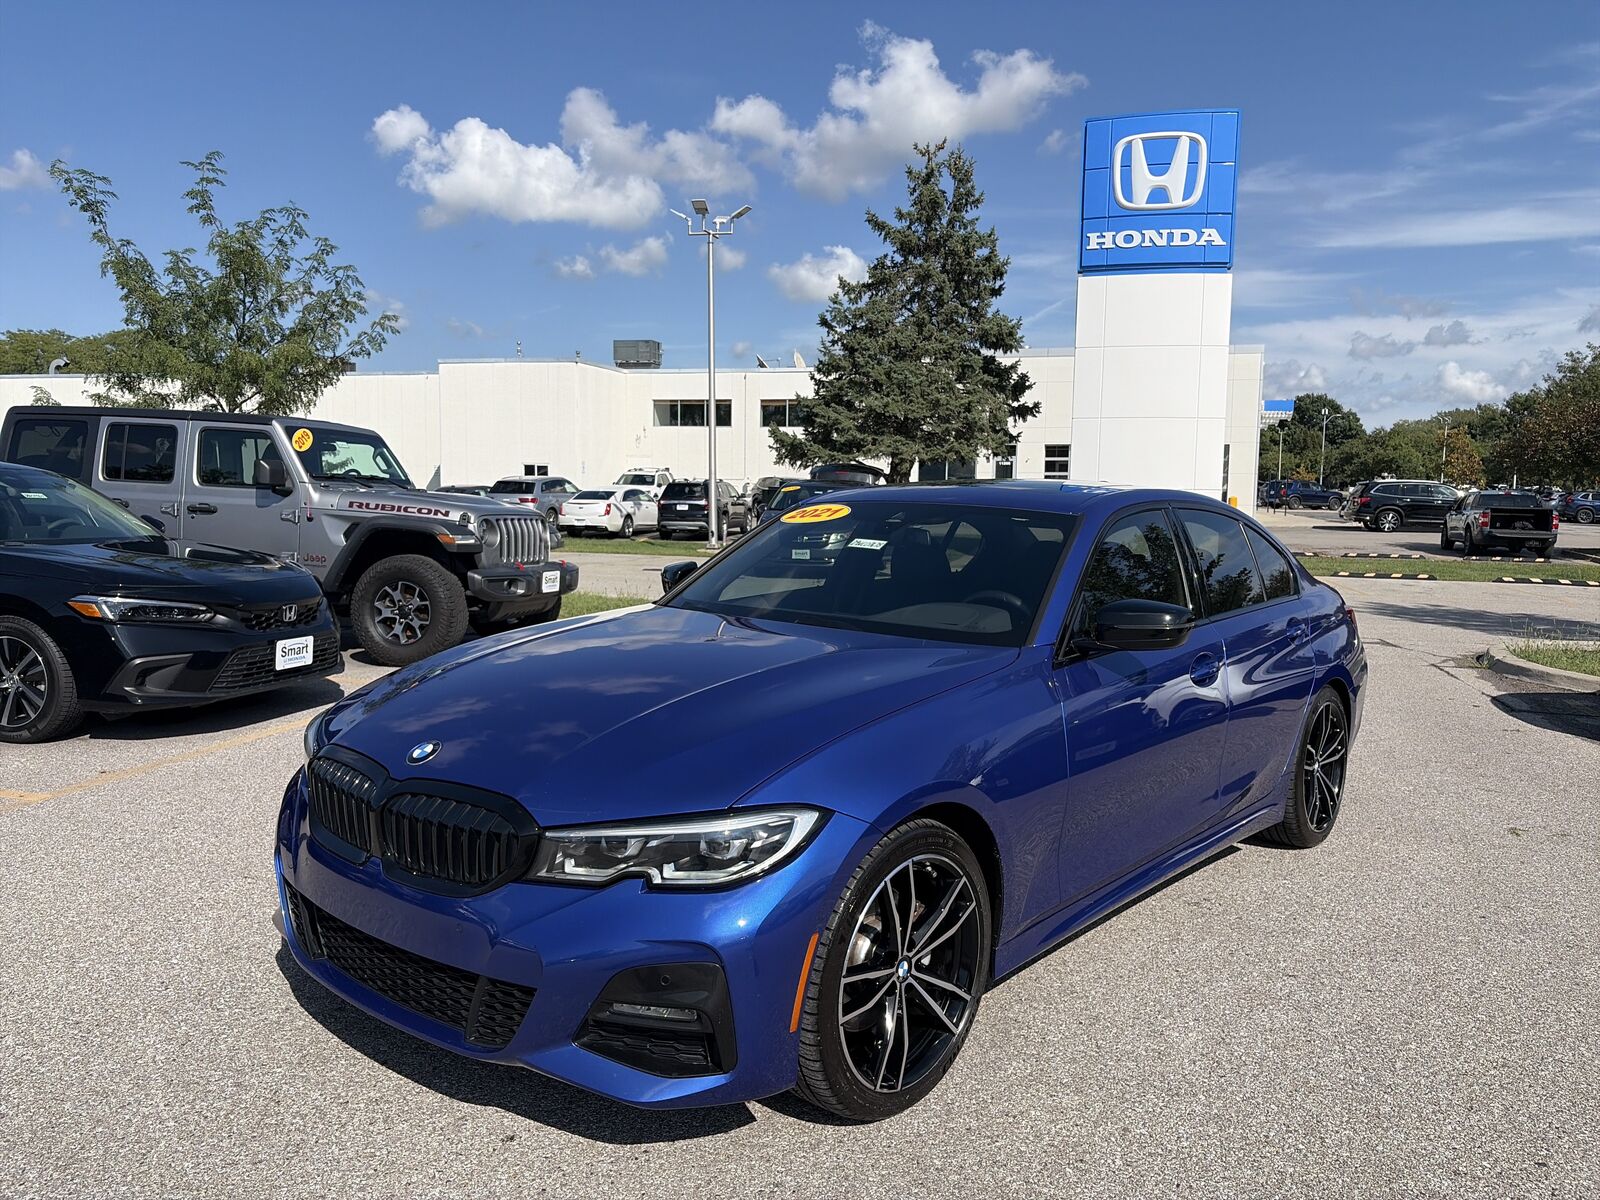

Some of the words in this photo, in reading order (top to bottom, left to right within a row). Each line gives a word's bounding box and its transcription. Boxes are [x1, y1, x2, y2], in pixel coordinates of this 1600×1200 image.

[1086, 228, 1227, 250] HONDA
[294, 430, 311, 449] 2019
[348, 501, 450, 517] RUBICON
[784, 507, 845, 520] 2021
[302, 553, 327, 564] Jeep
[280, 643, 309, 658] Smart
